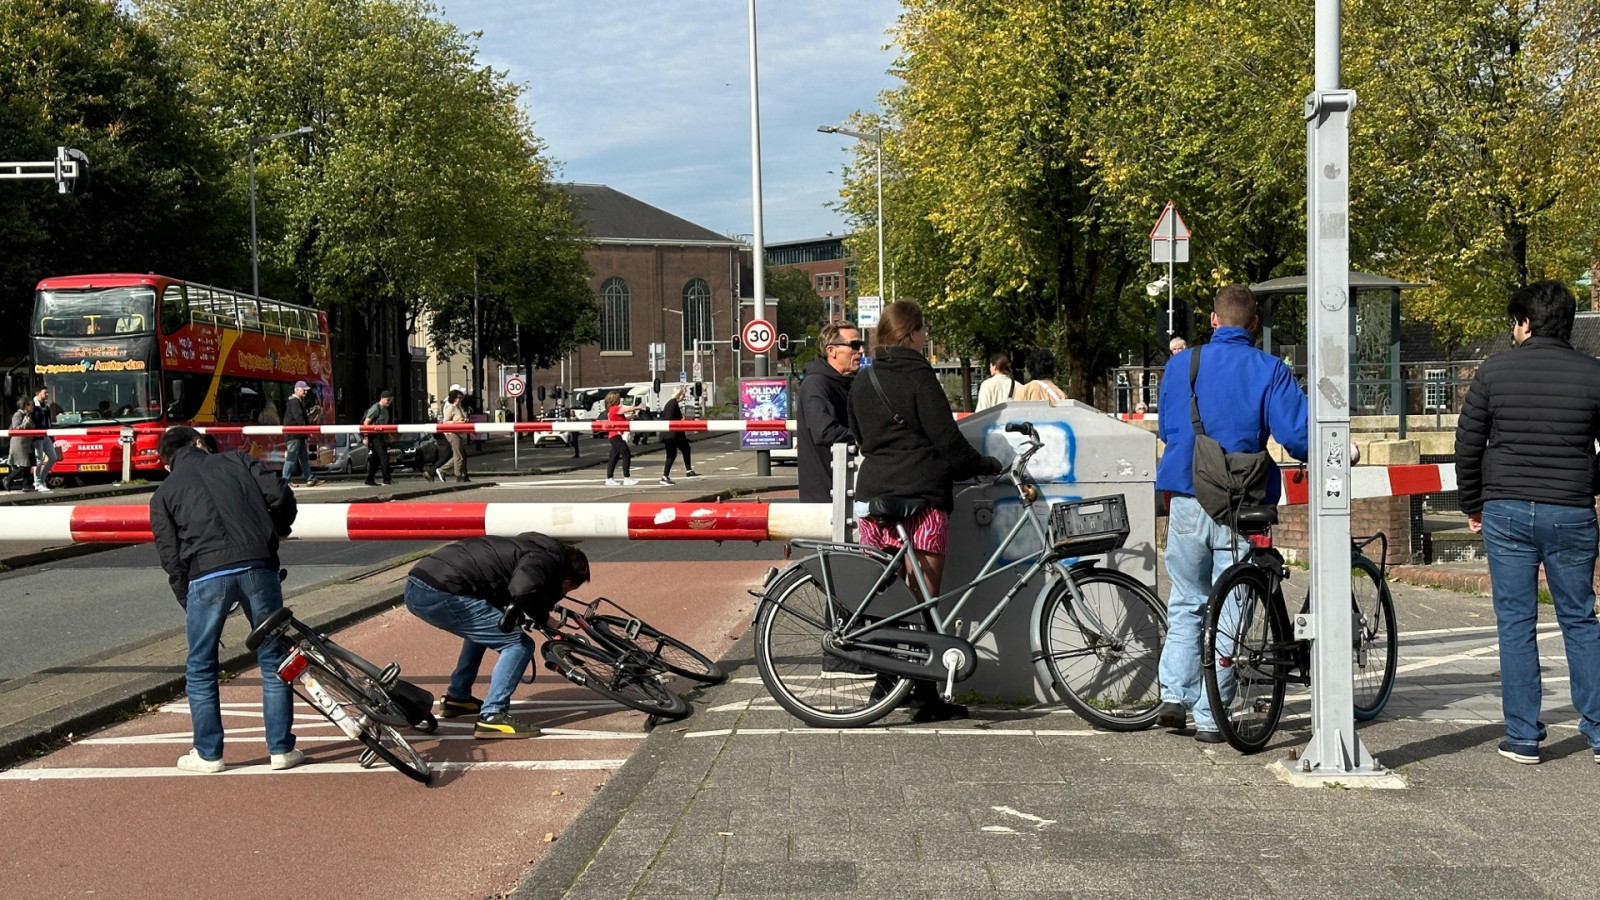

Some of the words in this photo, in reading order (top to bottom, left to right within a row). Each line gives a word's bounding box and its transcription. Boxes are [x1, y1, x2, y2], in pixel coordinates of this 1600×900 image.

[750, 330, 769, 342] 30
[94, 359, 145, 371] Amsterdam
[746, 386, 782, 395] HOLIDAY
[757, 394, 772, 403] ICE
